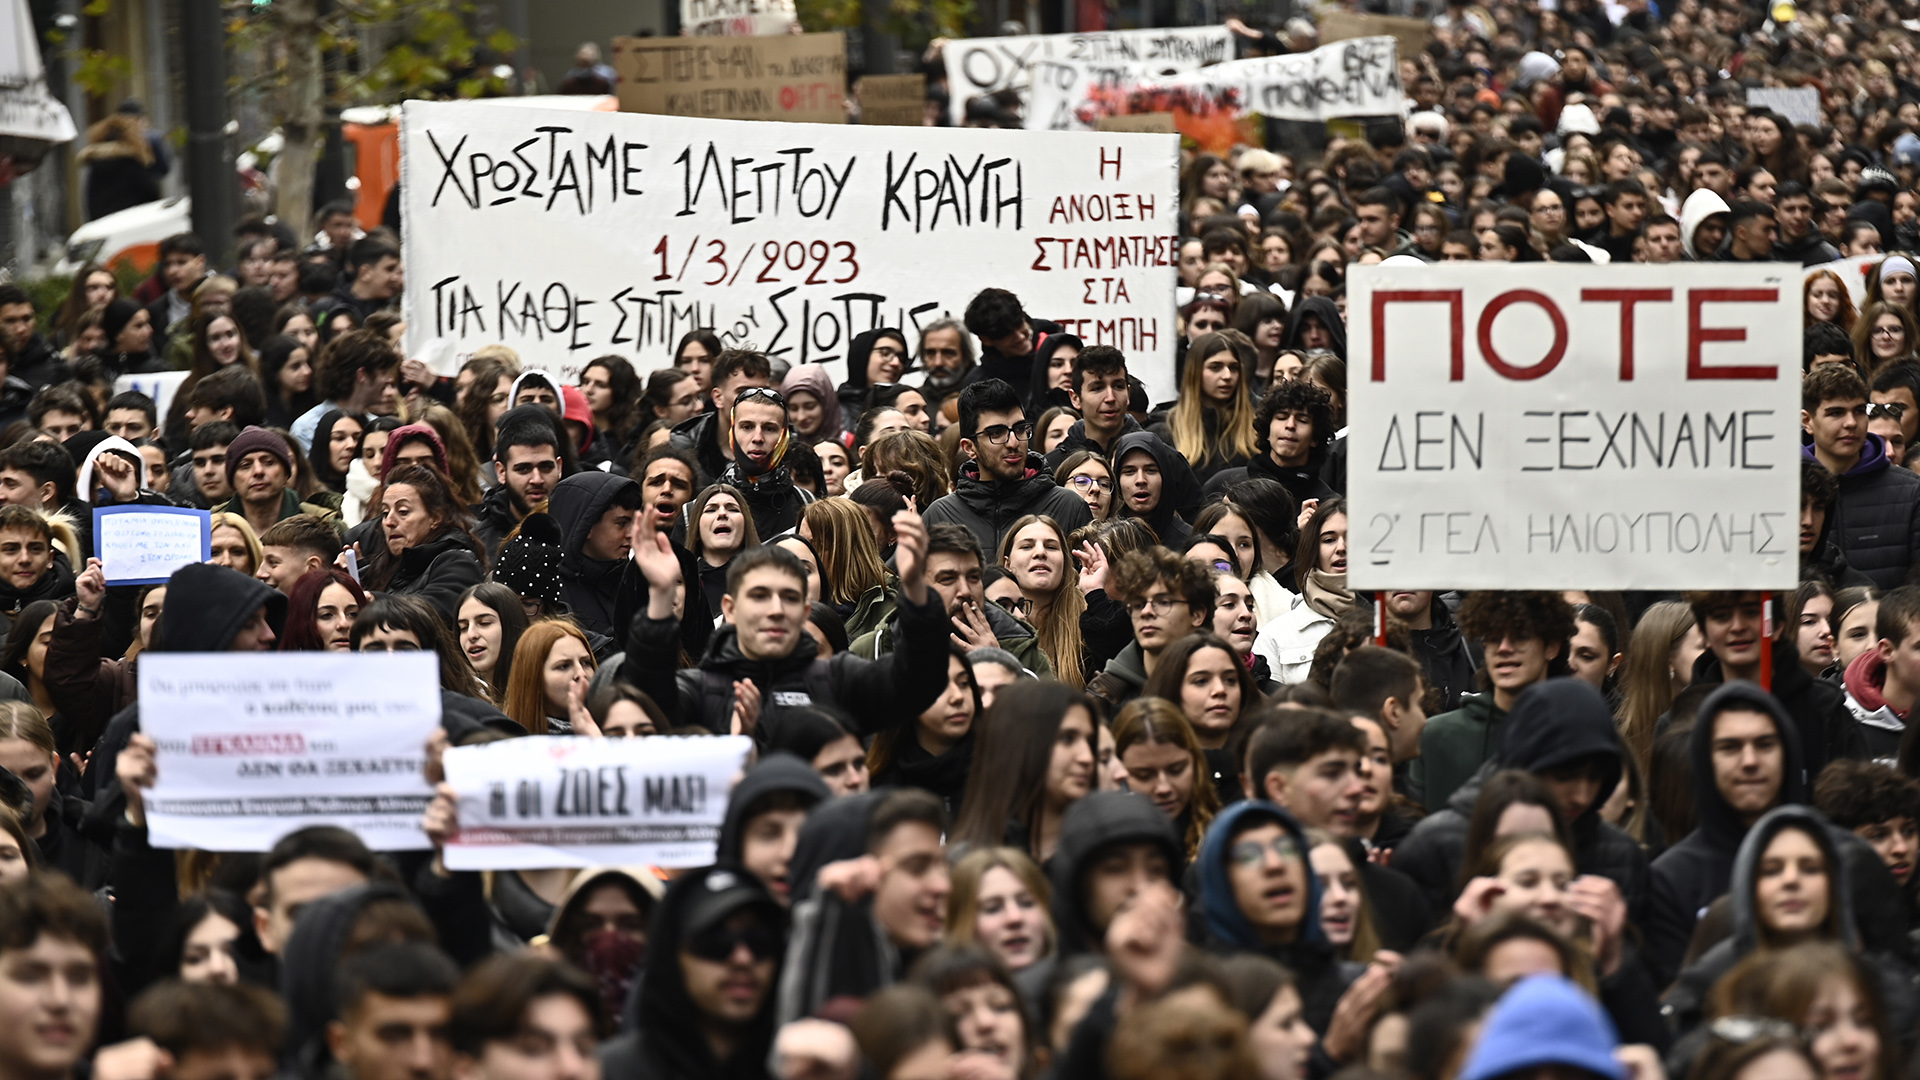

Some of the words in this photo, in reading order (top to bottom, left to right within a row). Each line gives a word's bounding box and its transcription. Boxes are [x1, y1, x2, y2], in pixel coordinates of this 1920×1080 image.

[1100, 147, 1122, 180] Η
[881, 150, 1022, 233] ΚΡΑΥΓΗ
[1049, 193, 1155, 224] ΑΝΟΙΞΗ
[652, 234, 859, 286] 1/3/2023
[1031, 235, 1180, 271] ΣΤΑΜΑΤΗΣΕ
[430, 275, 486, 339] ΓΙΑ
[497, 279, 596, 351] ΚΑΘΕ
[1083, 278, 1130, 304] ΣΤΑ
[1053, 317, 1157, 352] ΤΕΜΠΗ
[1370, 287, 1780, 383] ΠΟΤΕ
[1378, 410, 1484, 472] ΔΕΝ
[1520, 409, 1775, 471] ΞΕΧΝΑΜΕ
[1418, 511, 1500, 555] ΓΕΛ
[1527, 511, 1787, 555] ΗΛΙΟΥΠΟΛΗΣ
